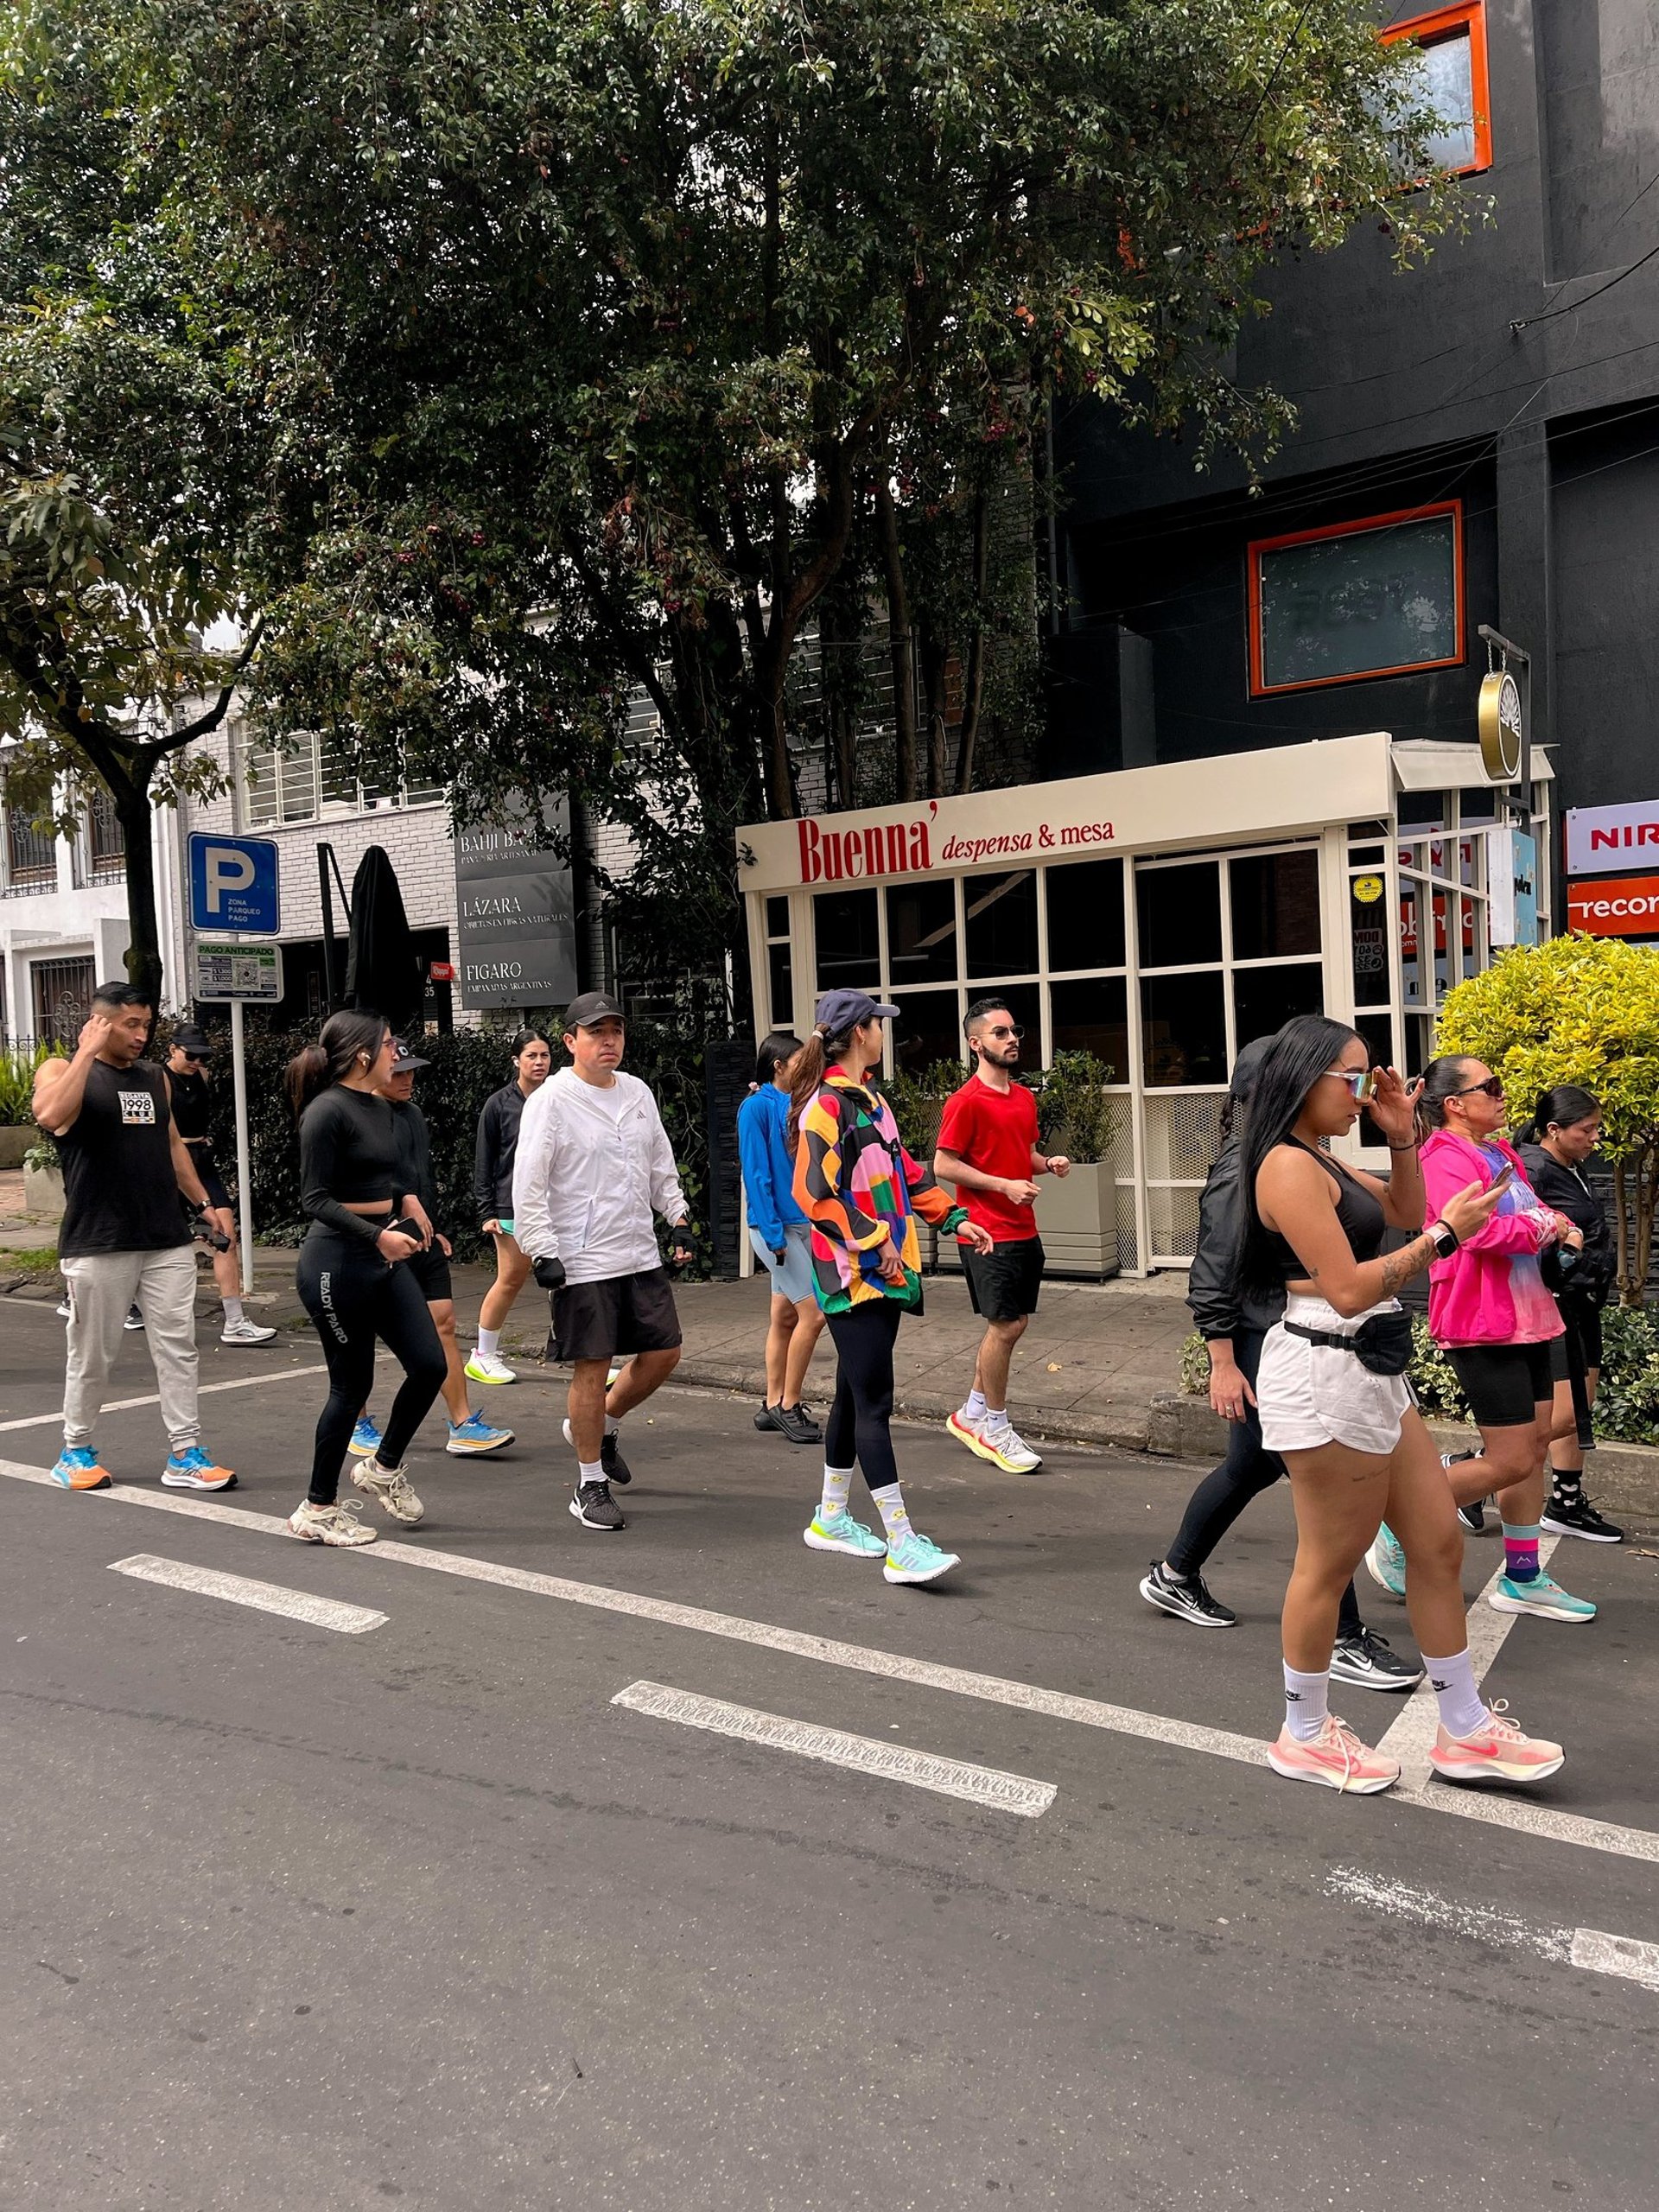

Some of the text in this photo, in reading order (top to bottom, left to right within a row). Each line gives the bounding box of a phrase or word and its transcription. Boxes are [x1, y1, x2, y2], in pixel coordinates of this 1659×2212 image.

[461, 833, 499, 853] BAHJI
[942, 832, 1033, 863] despensa
[1038, 823, 1056, 848] &
[1060, 822, 1115, 845] mesa
[205, 846, 256, 913] P
[227, 898, 247, 906] ZONA
[462, 896, 522, 917] LÁZARA
[227, 906, 262, 915] PARQUEO
[227, 914, 249, 923] PAGO
[199, 945, 274, 956] PAGO ANTICIPADO
[466, 962, 522, 981] FIGARO
[424, 986, 435, 997] 35
[467, 980, 552, 994] EMPANADAS ARGENTINAS
[121, 1099, 151, 1110] 1998
[320, 1271, 348, 1344] READY PARD
